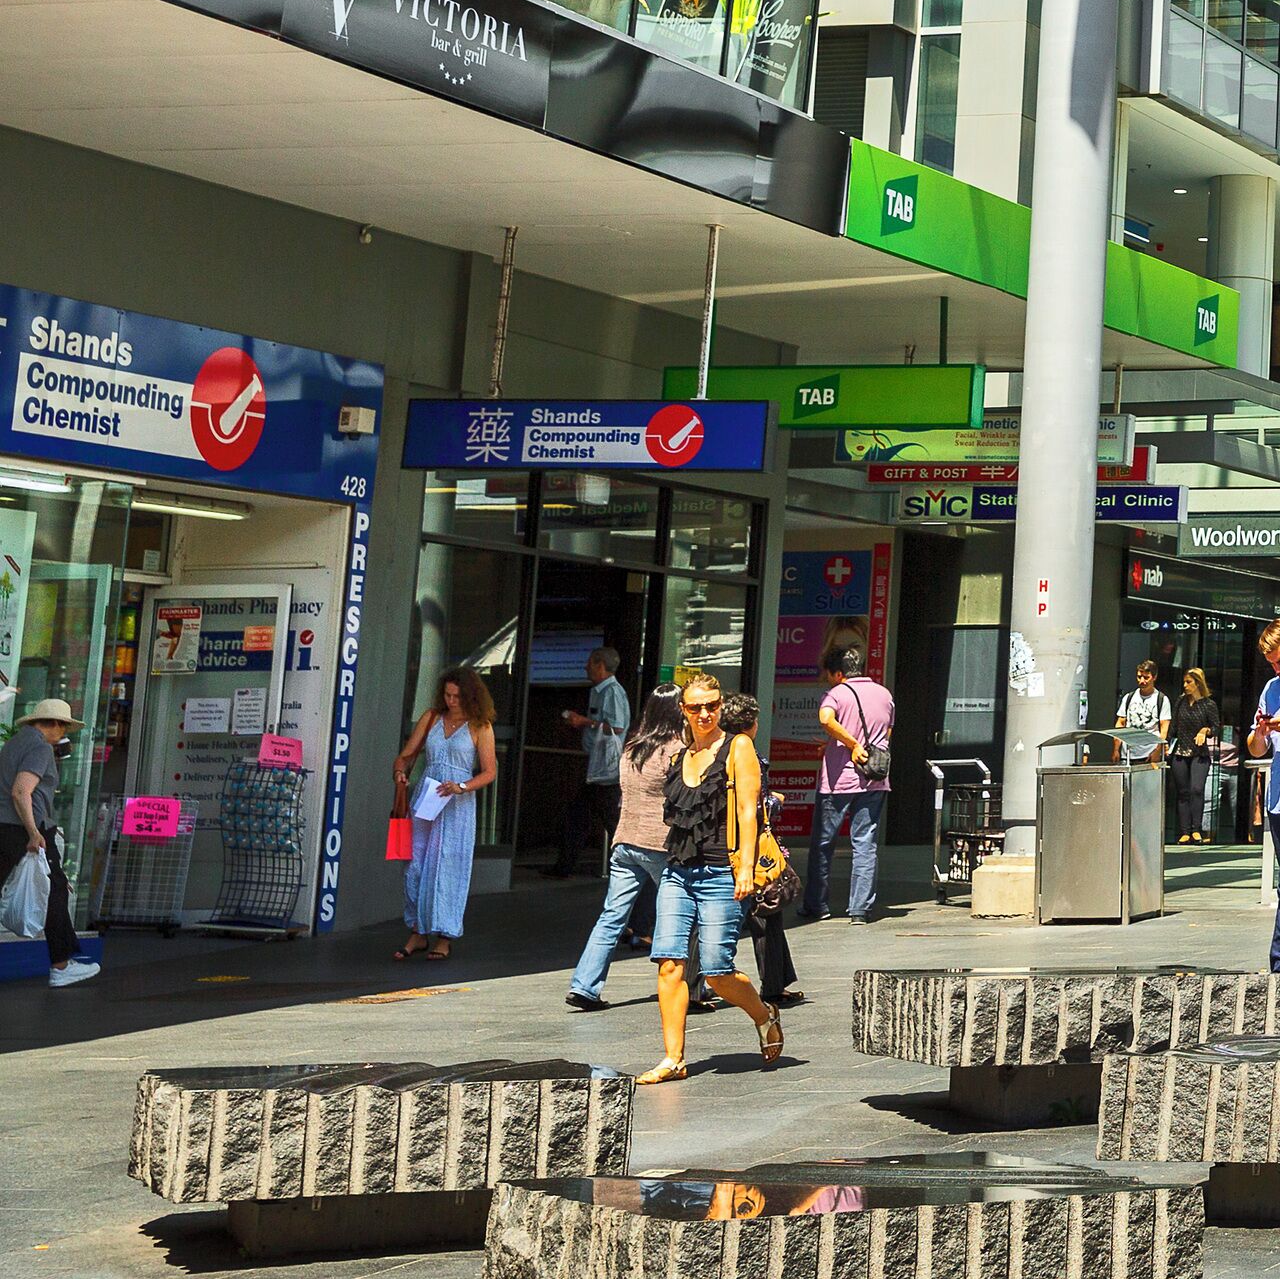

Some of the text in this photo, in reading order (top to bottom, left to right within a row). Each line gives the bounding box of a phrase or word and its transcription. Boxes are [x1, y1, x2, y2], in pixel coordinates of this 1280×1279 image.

[659, 8, 708, 42] SAPPORO
[430, 29, 487, 67] bar & grill
[886, 188, 914, 223] TAB
[1197, 306, 1217, 334] TAB
[29, 315, 133, 367] Shands
[26, 362, 184, 420] Compounding
[799, 387, 835, 406] TAB
[22, 396, 121, 437] Chemist
[530, 408, 602, 425] Shands
[465, 407, 514, 463] 藥
[528, 429, 641, 446] Compounding
[527, 444, 595, 459] Chemist
[884, 467, 968, 479] GIFT & POST
[340, 475, 367, 498] 428
[1124, 493, 1174, 507] Clinic
[1038, 580, 1048, 593] H
[1144, 565, 1164, 588] nab
[1037, 603, 1047, 616] P
[321, 511, 370, 922] PRESCRIPTIONS
[212, 740, 238, 750] Health
